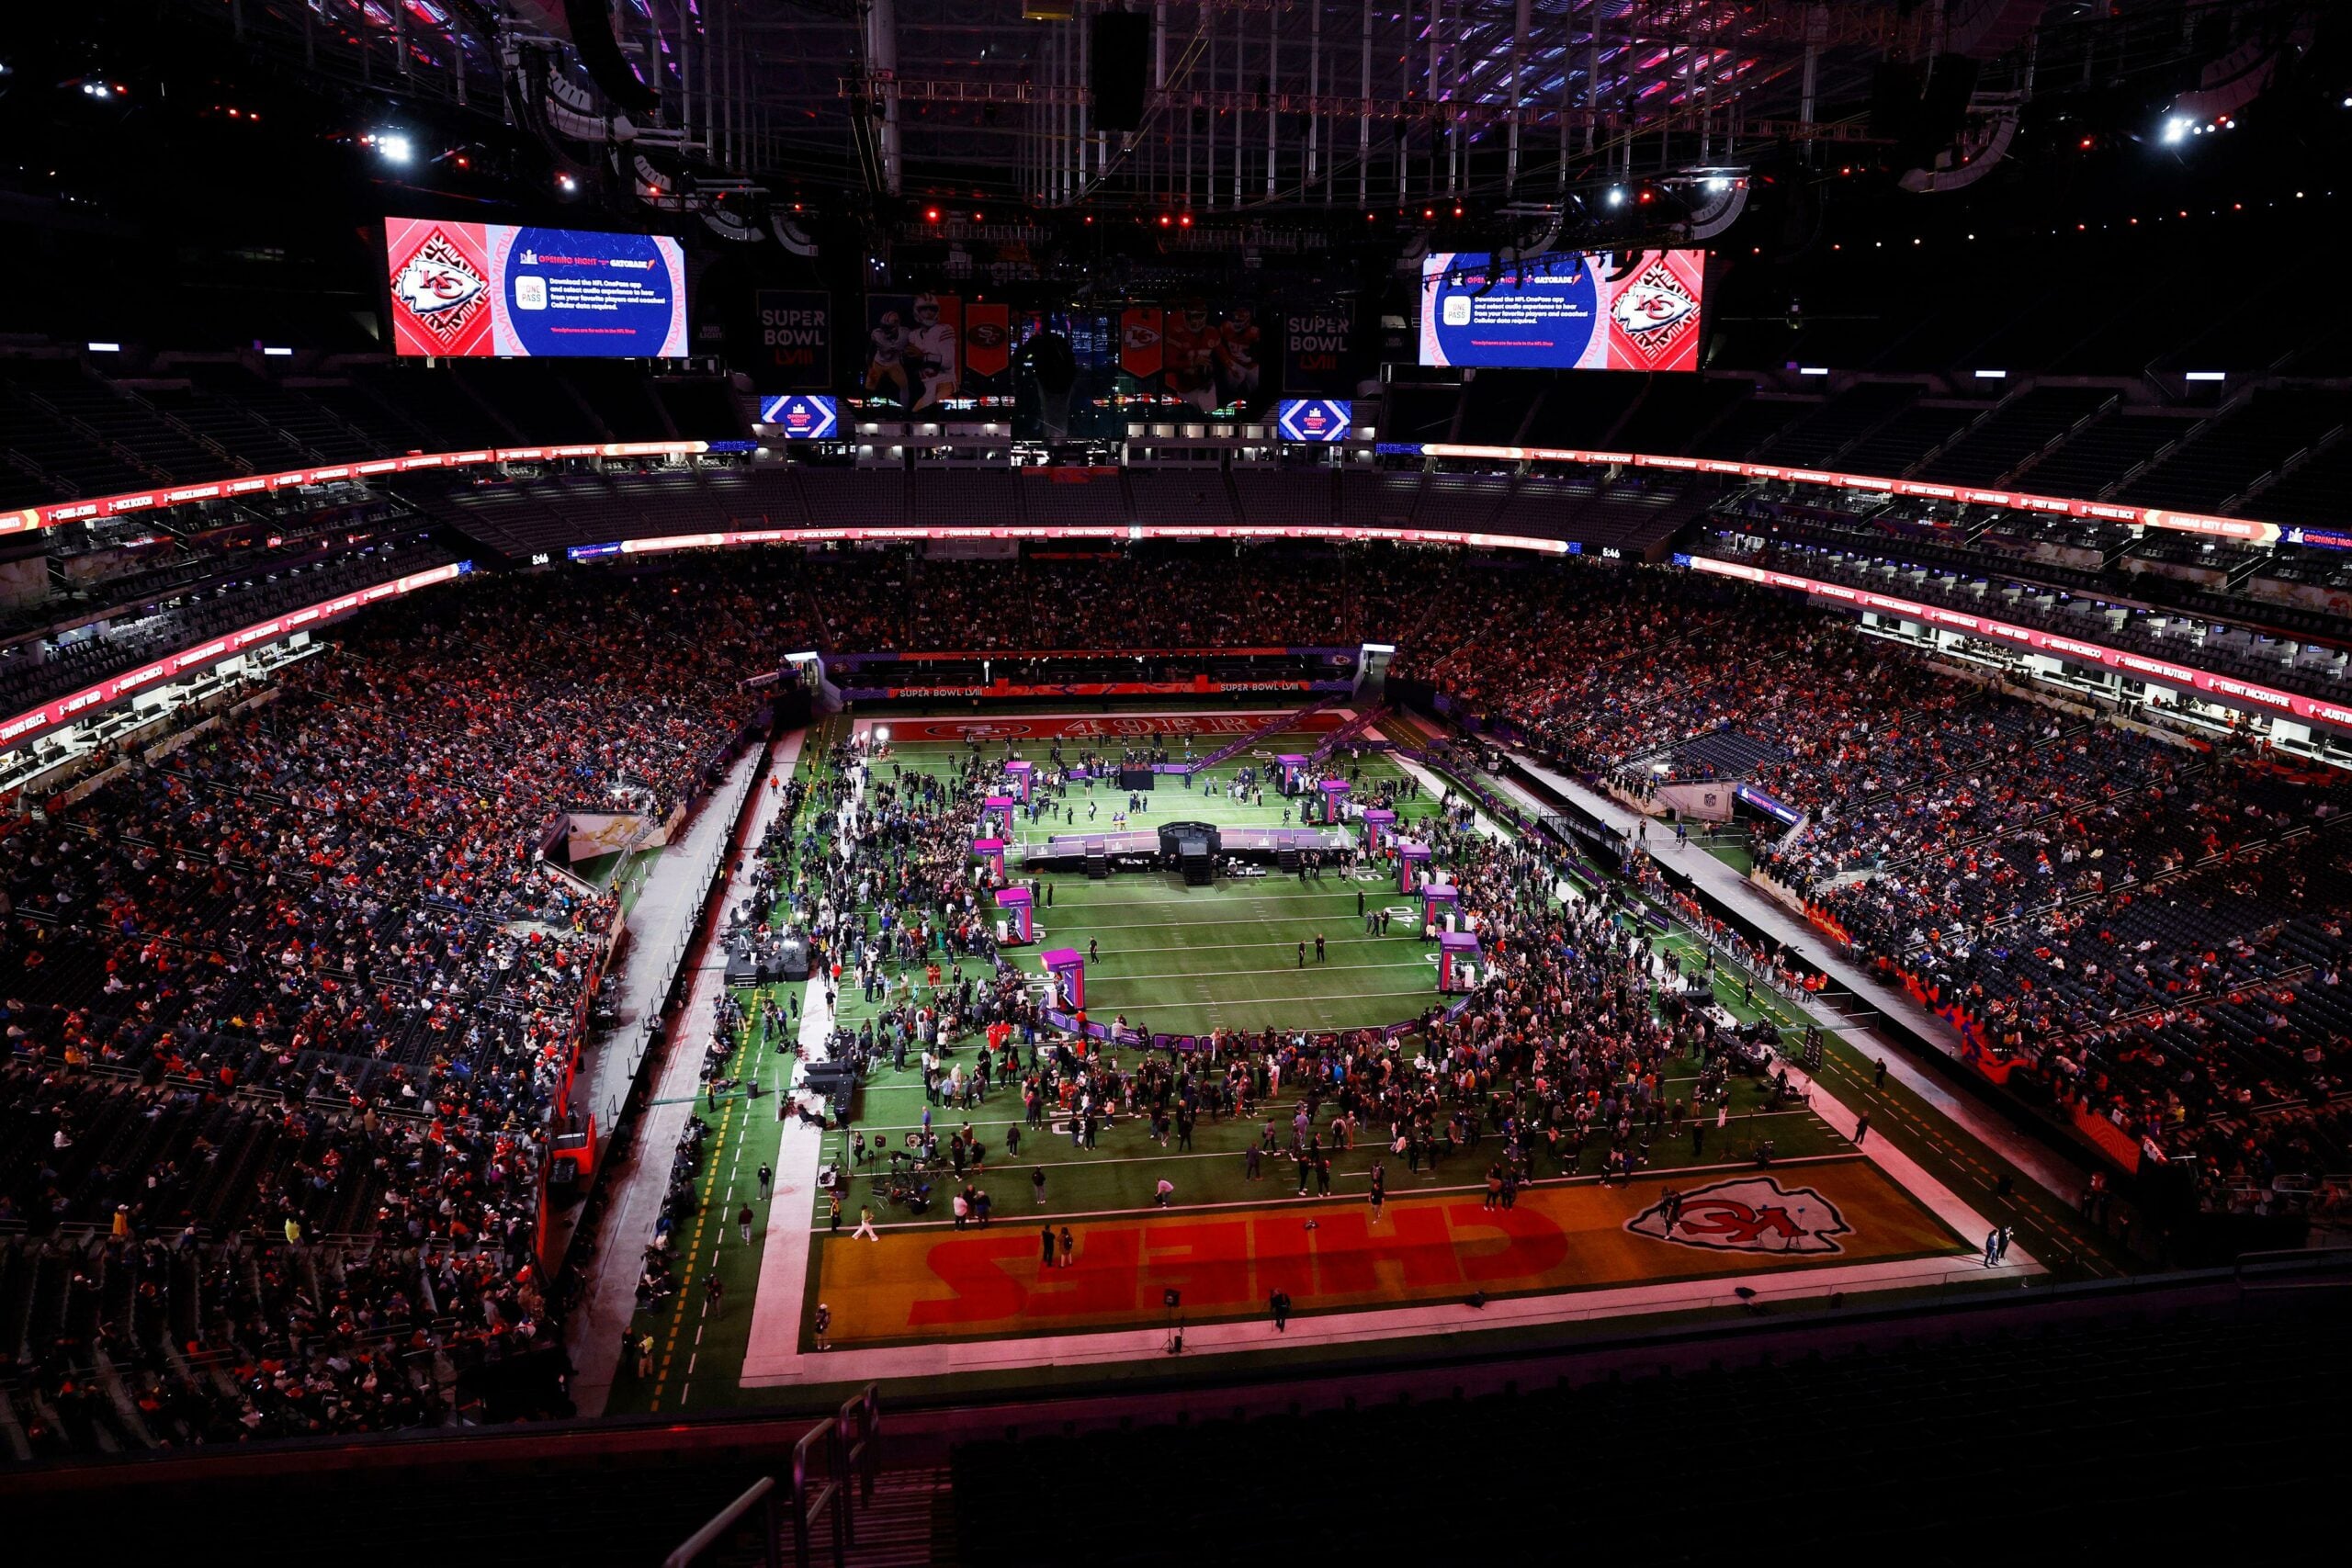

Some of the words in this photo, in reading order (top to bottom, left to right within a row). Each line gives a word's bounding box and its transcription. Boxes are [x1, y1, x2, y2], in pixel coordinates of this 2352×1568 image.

[538, 255, 572, 265] OPENING
[574, 257, 597, 265] NIGHT
[610, 260, 648, 269] GATORADE
[549, 277, 581, 286] Download
[629, 282, 641, 290] app
[1534, 276, 1573, 285] GATORADE
[526, 285, 540, 293] ONE
[522, 294, 541, 302] PASS
[762, 309, 825, 327] SUPER
[1288, 317, 1350, 333] SUPER
[764, 329, 824, 345] BOWL
[1290, 335, 1349, 352] BOWL
[775, 348, 814, 366] LVIII
[1300, 354, 1338, 370] LVIII
[2169, 516, 2200, 528] KANSAS
[2201, 521, 2221, 530] CITY
[2222, 523, 2251, 534] CHIEFS
[2304, 534, 2336, 545] OPENING
[2337, 537, 2352, 547] NIG
[1602, 547, 1621, 558] 5:46
[2069, 643, 2101, 658] PACHECO
[135, 666, 163, 683] PACHECO
[2125, 657, 2163, 673] HARRISON
[2163, 666, 2193, 681] BUTKER
[899, 689, 929, 697] SUPER
[933, 688, 962, 696] BOWL
[965, 687, 983, 697] LVIII
[1220, 683, 1249, 692] SUPER
[1282, 682, 1299, 691] LVIII
[2220, 681, 2246, 694] TRENT
[2245, 687, 2290, 706] MCDUFFIE
[59, 705, 63, 715] 5
[69, 696, 86, 711] ANDY
[2309, 704, 2315, 713] 9
[2322, 707, 2352, 723] JUSTIN
[0, 720, 26, 739] TRAVIS
[25, 712, 47, 729] KELCE
[1066, 716, 1301, 736] 49ERS
[908, 1204, 1569, 1325] CHIEFS
